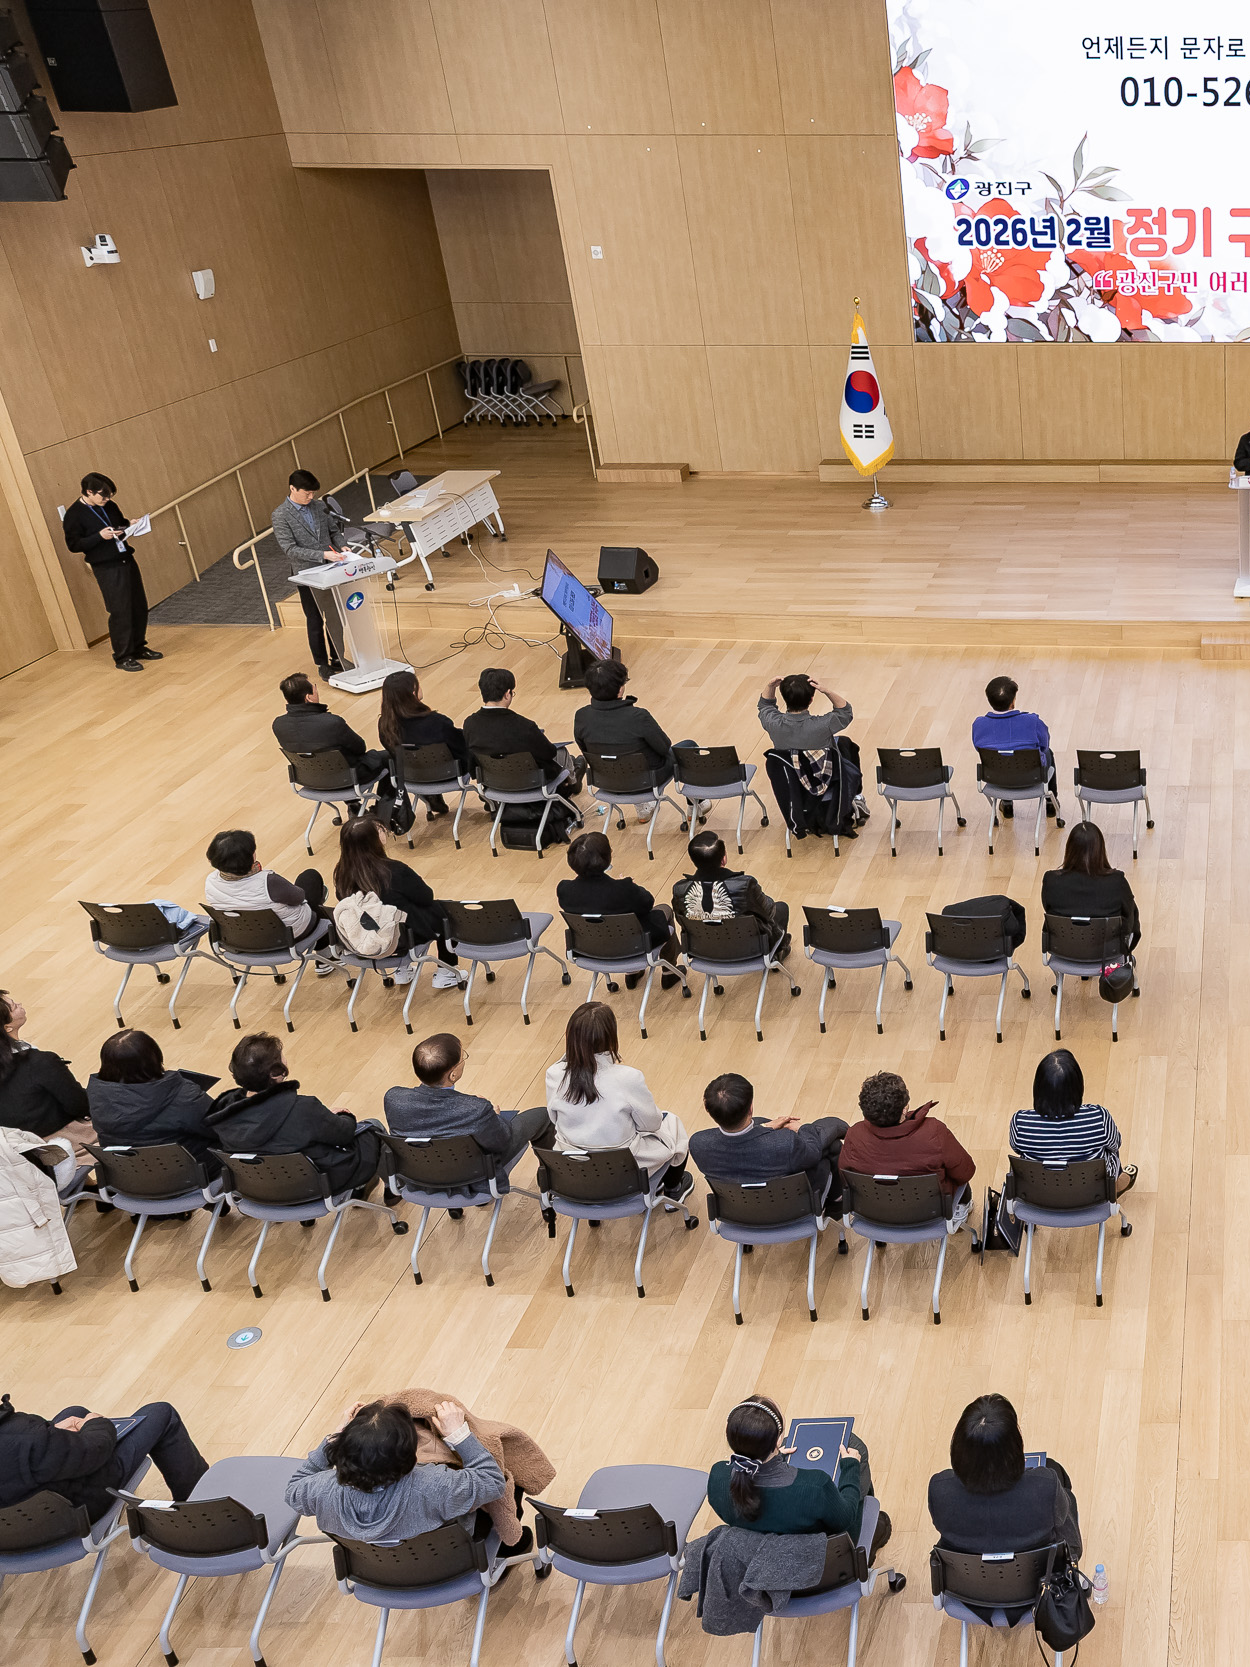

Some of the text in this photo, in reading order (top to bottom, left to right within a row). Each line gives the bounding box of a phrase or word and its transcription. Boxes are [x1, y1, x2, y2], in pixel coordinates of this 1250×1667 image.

[1081, 35, 1168, 60] 언제든지
[1180, 35, 1246, 60] 문자로
[974, 181, 1032, 196] 광진구
[956, 215, 1057, 249] 2026년
[1066, 215, 1112, 249] 2월
[1126, 206, 1212, 258] 정기
